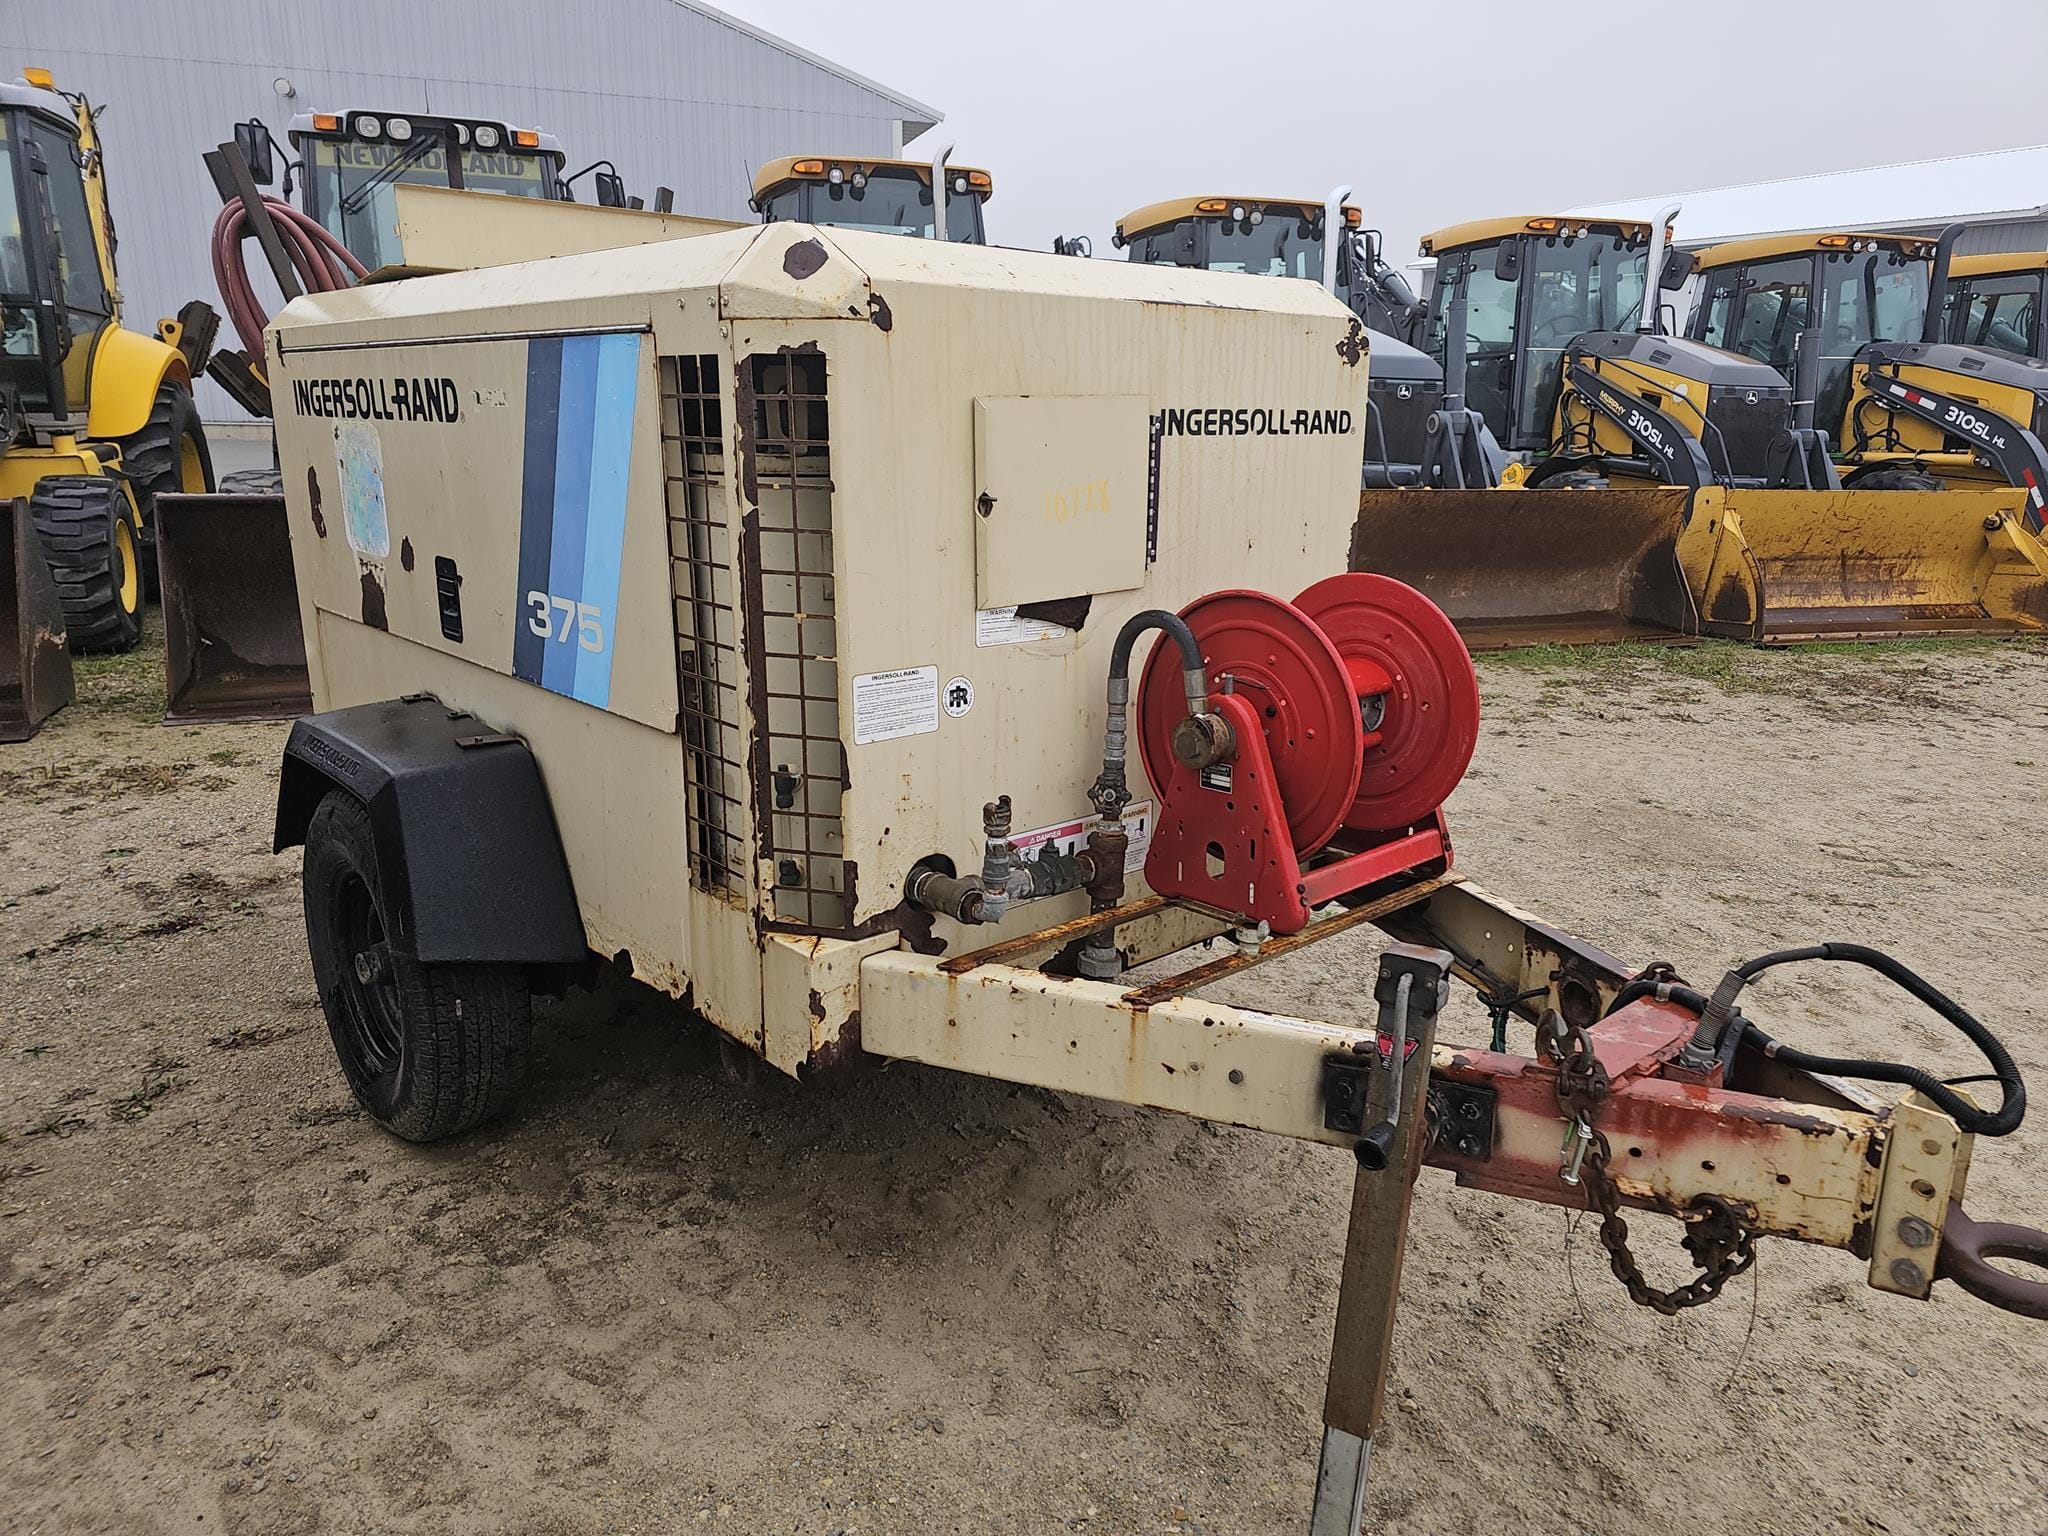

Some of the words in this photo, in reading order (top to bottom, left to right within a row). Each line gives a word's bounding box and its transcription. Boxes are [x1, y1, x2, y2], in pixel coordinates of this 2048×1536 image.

[409, 147, 524, 176] OAND
[292, 378, 459, 423] INGERSOLL-RAND
[1160, 408, 1351, 436] INGERSOLL-RAND
[1628, 409, 1663, 450] 310SL
[1663, 444, 1675, 460] HL
[1944, 405, 1990, 441] 310SL
[1992, 434, 2006, 449] HL
[527, 590, 605, 654] 375
